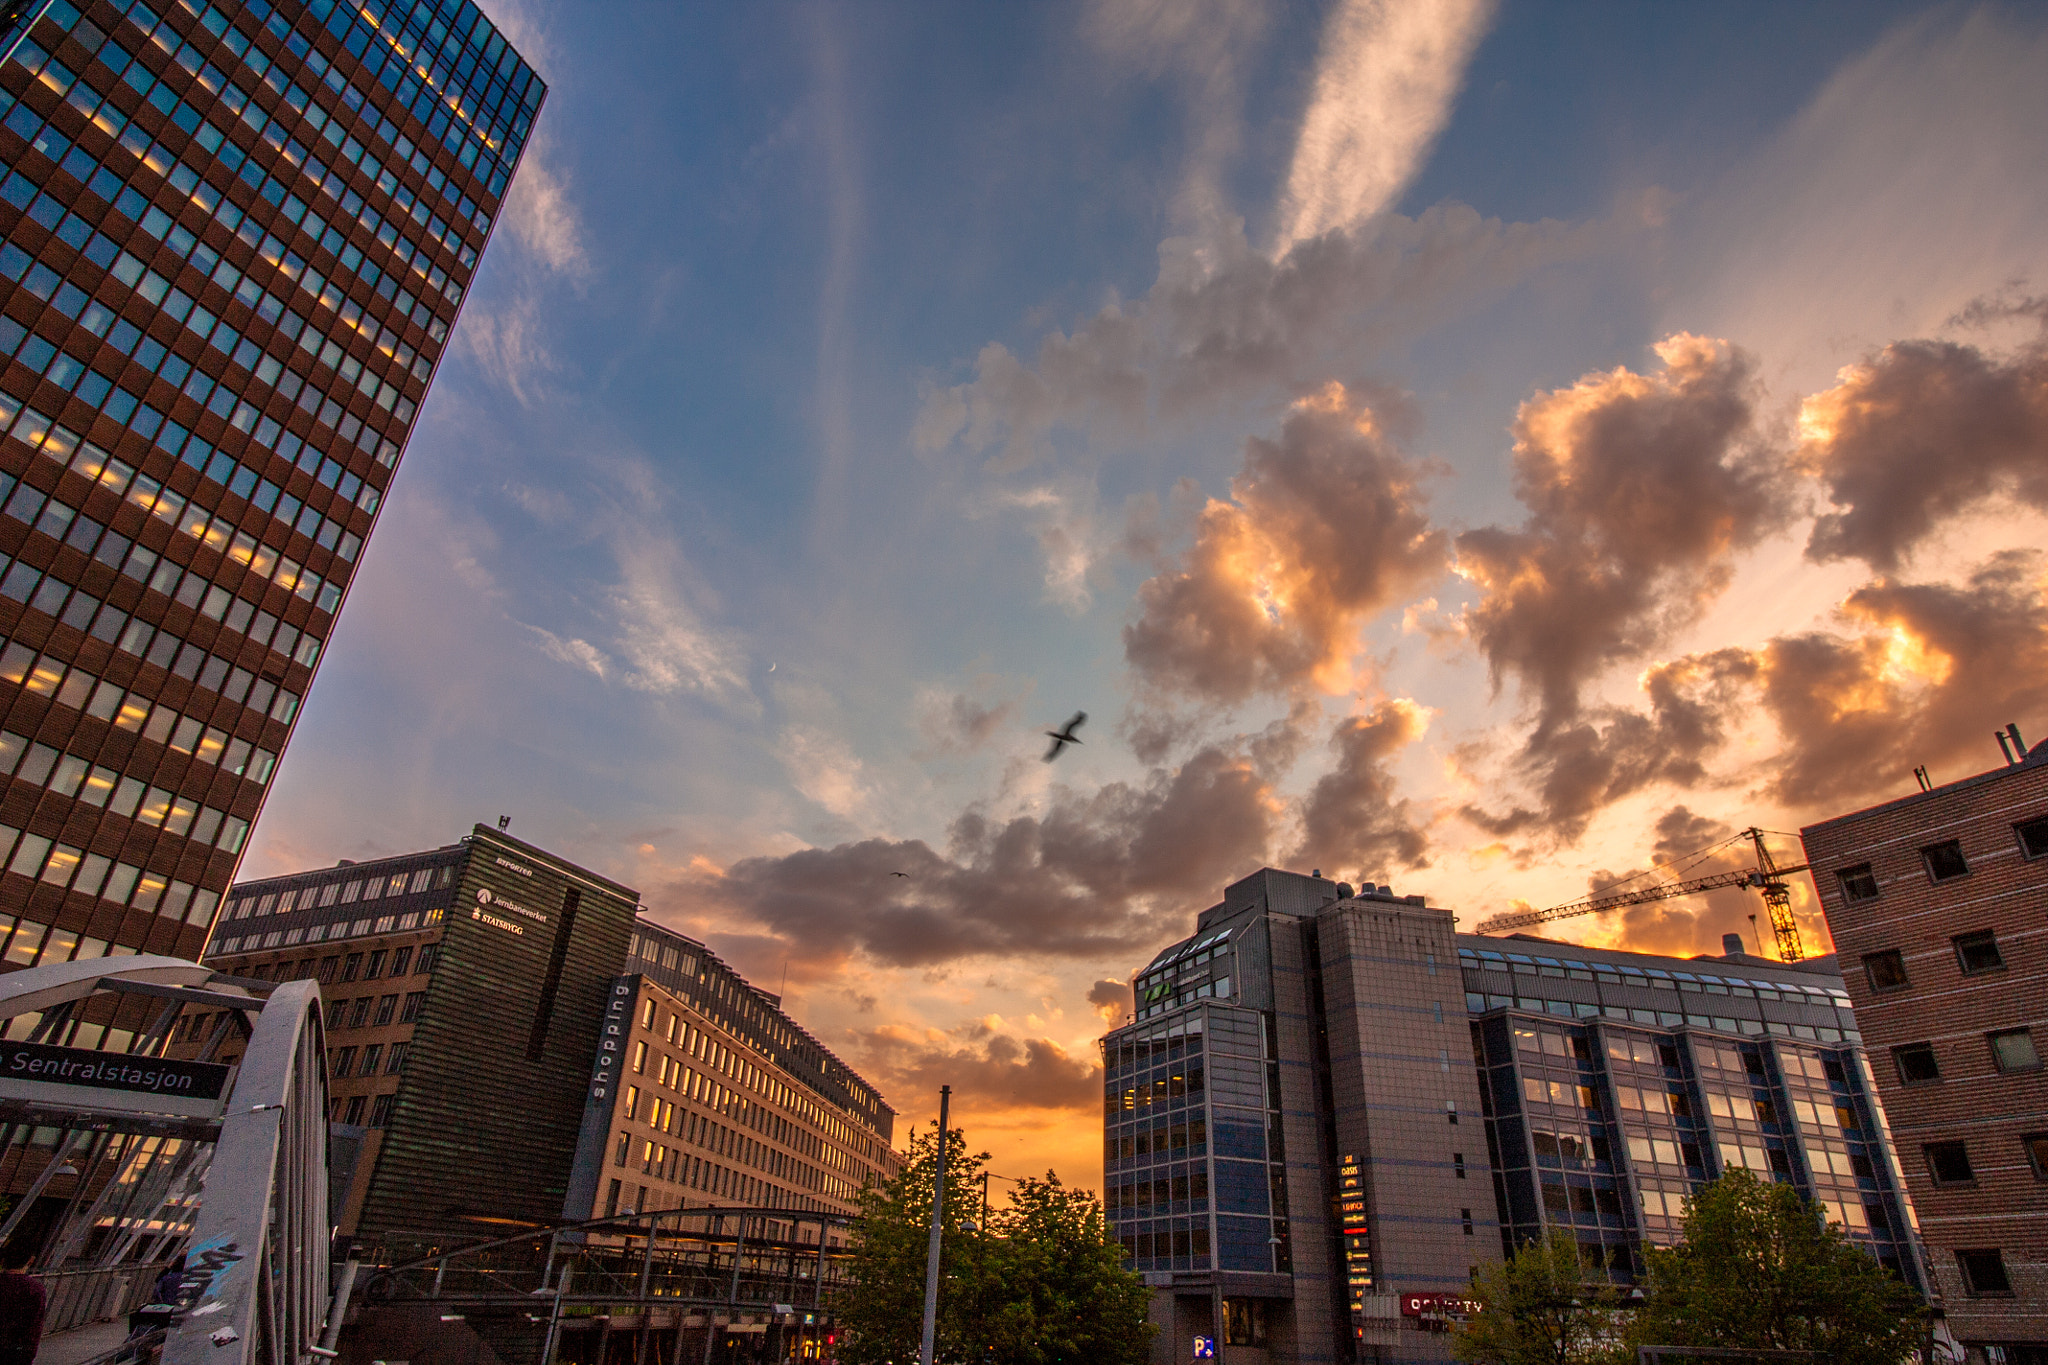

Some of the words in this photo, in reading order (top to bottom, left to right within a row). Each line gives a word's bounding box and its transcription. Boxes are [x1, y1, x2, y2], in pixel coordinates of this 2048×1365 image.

[494, 896, 547, 923] Jernbaneverket
[481, 914, 524, 935] STATSBYGG
[594, 985, 630, 1098] shopping
[10, 1051, 193, 1090] Sentralstasjon
[1194, 1338, 1205, 1357] P
